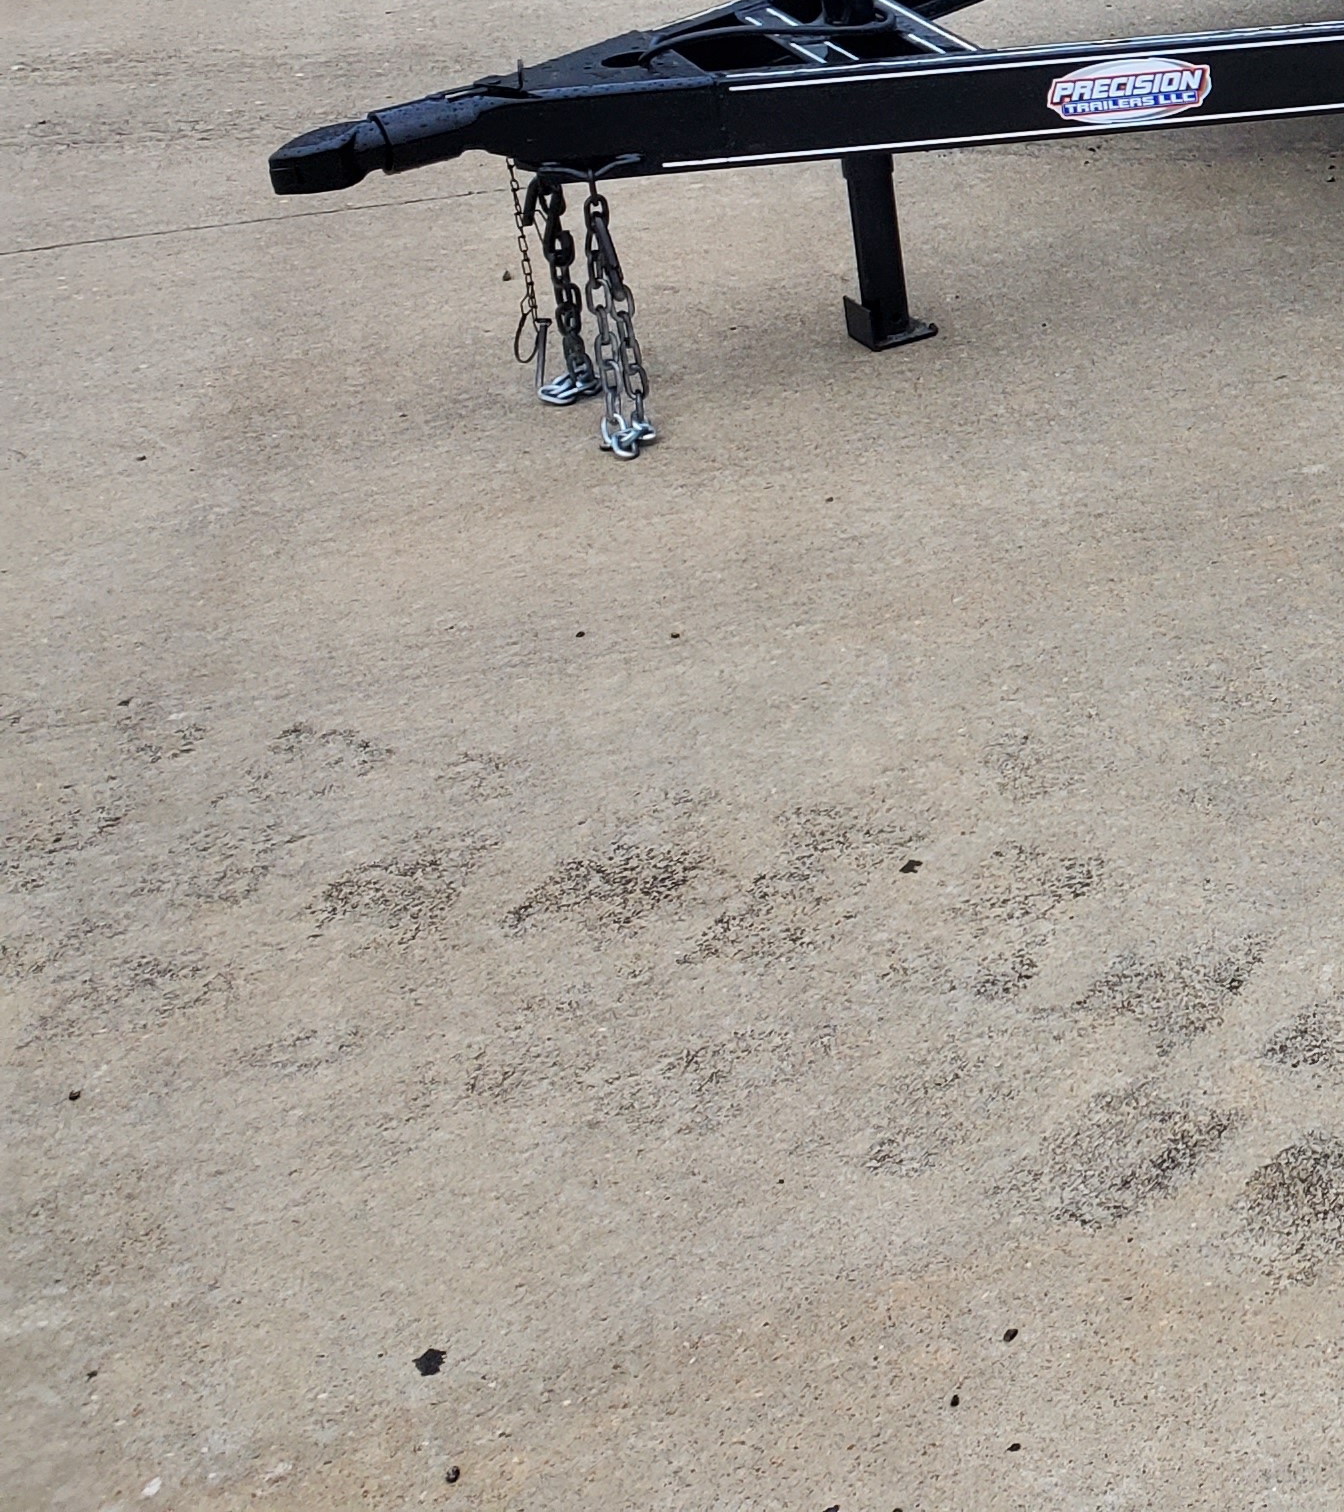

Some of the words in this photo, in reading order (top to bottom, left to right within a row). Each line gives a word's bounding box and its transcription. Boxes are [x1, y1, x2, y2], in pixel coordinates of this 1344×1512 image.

[1052, 69, 1203, 103] PRECISION
[1064, 94, 1155, 114] TRAILERS
[1158, 91, 1197, 105] LLC
